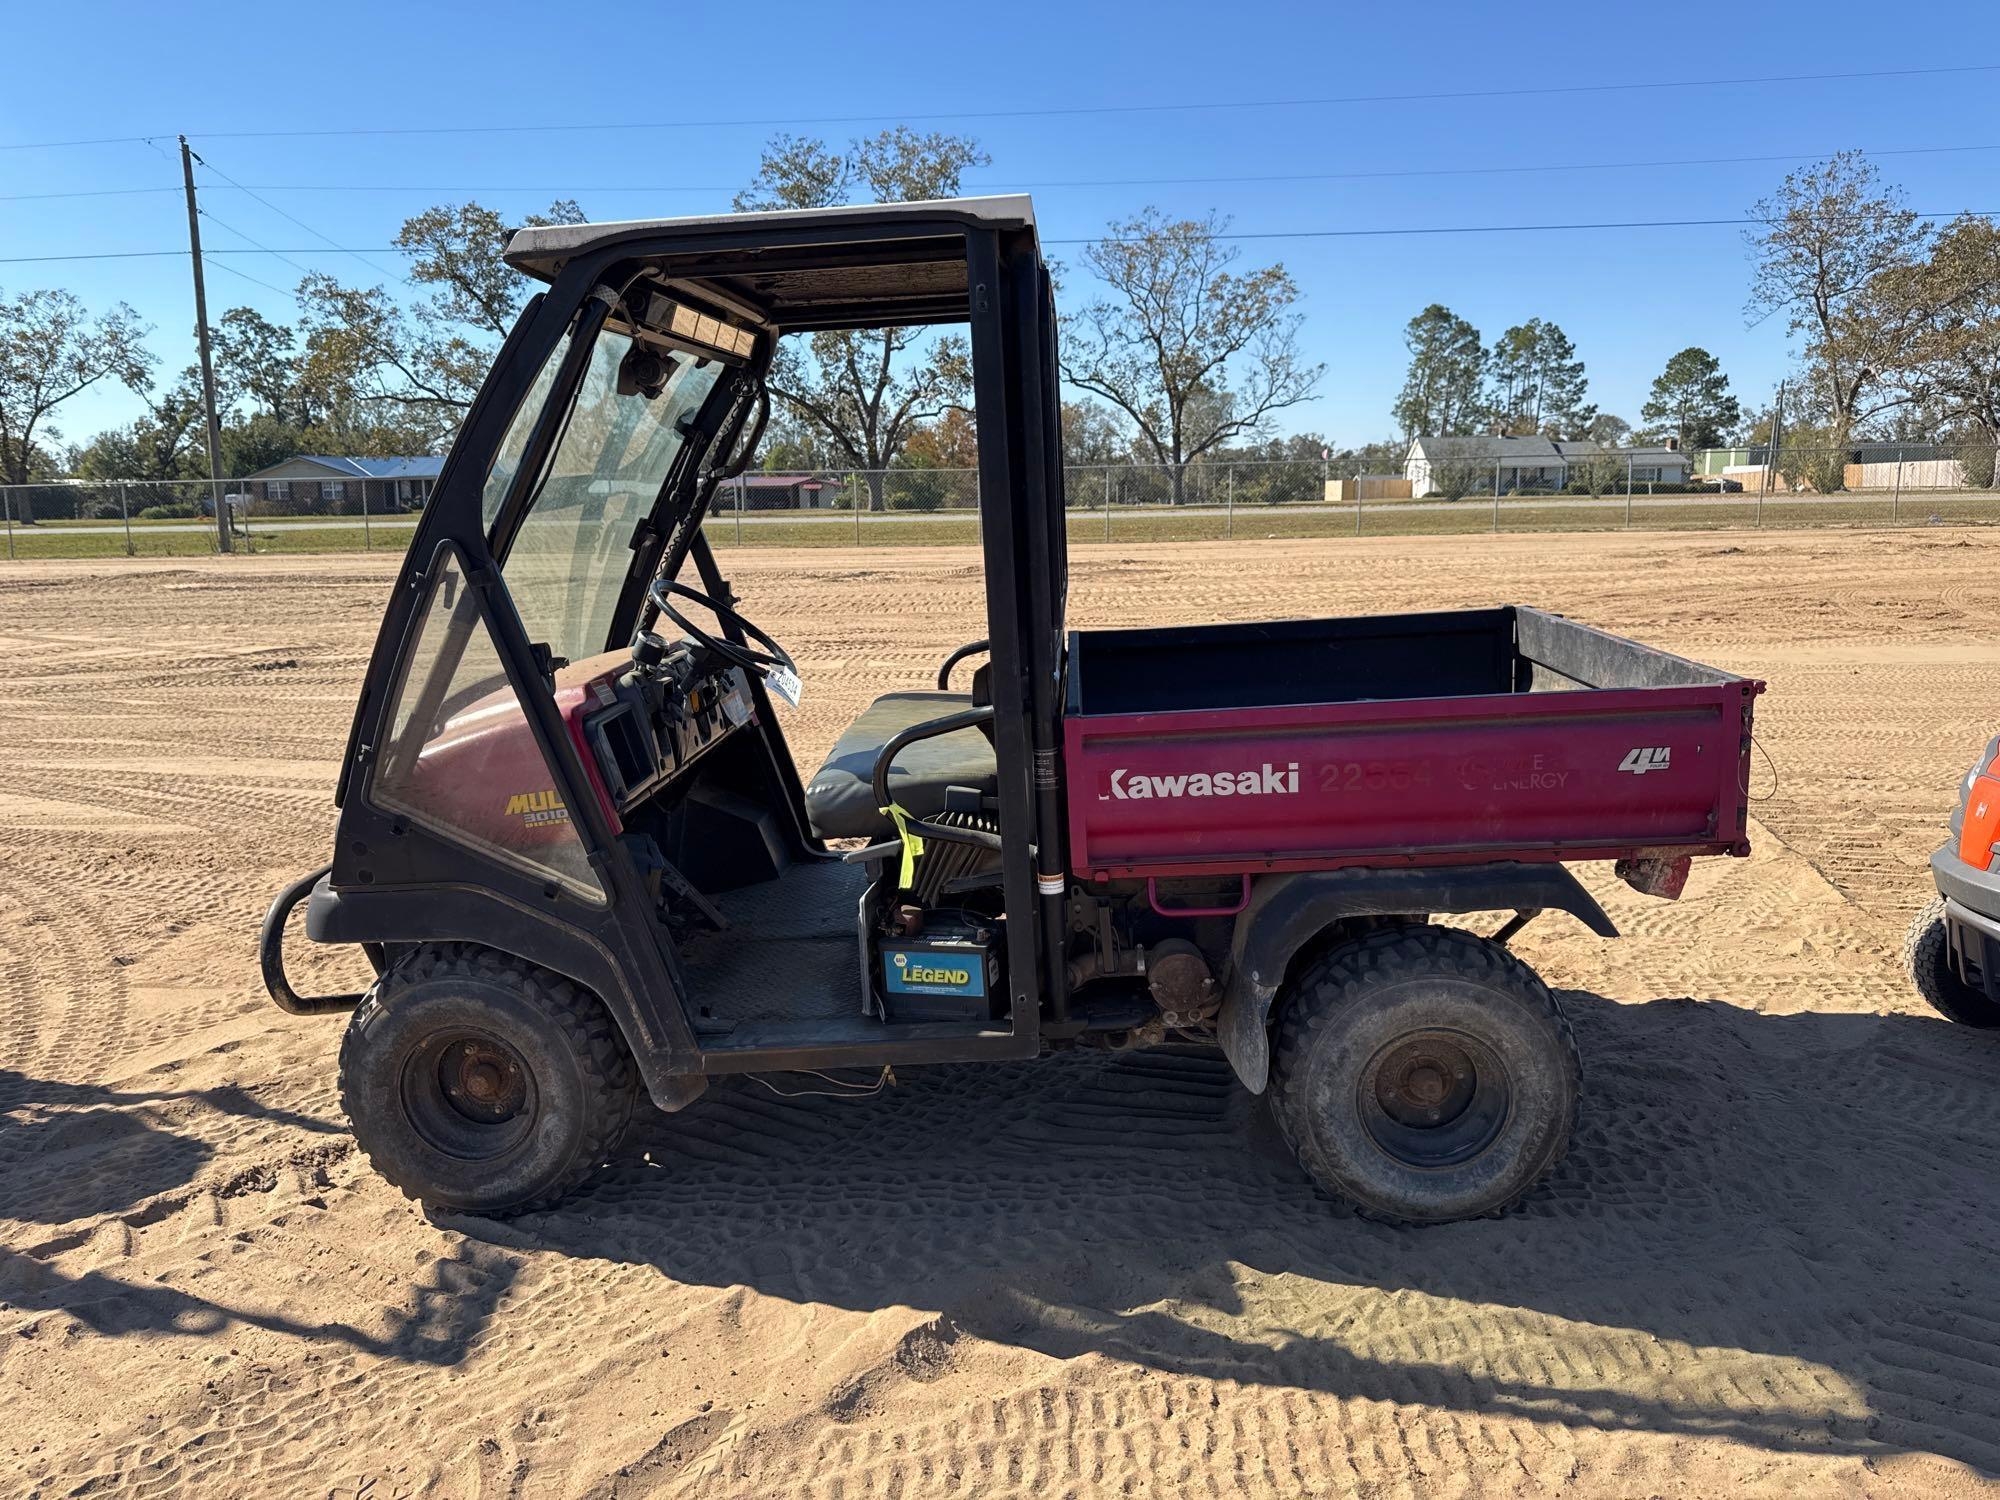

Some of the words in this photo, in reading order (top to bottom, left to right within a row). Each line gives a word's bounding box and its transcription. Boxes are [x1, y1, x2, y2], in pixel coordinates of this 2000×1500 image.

[1099, 762, 1299, 800] Kawasaki
[504, 791, 565, 815] MUL
[902, 968, 969, 984] LEGEND
